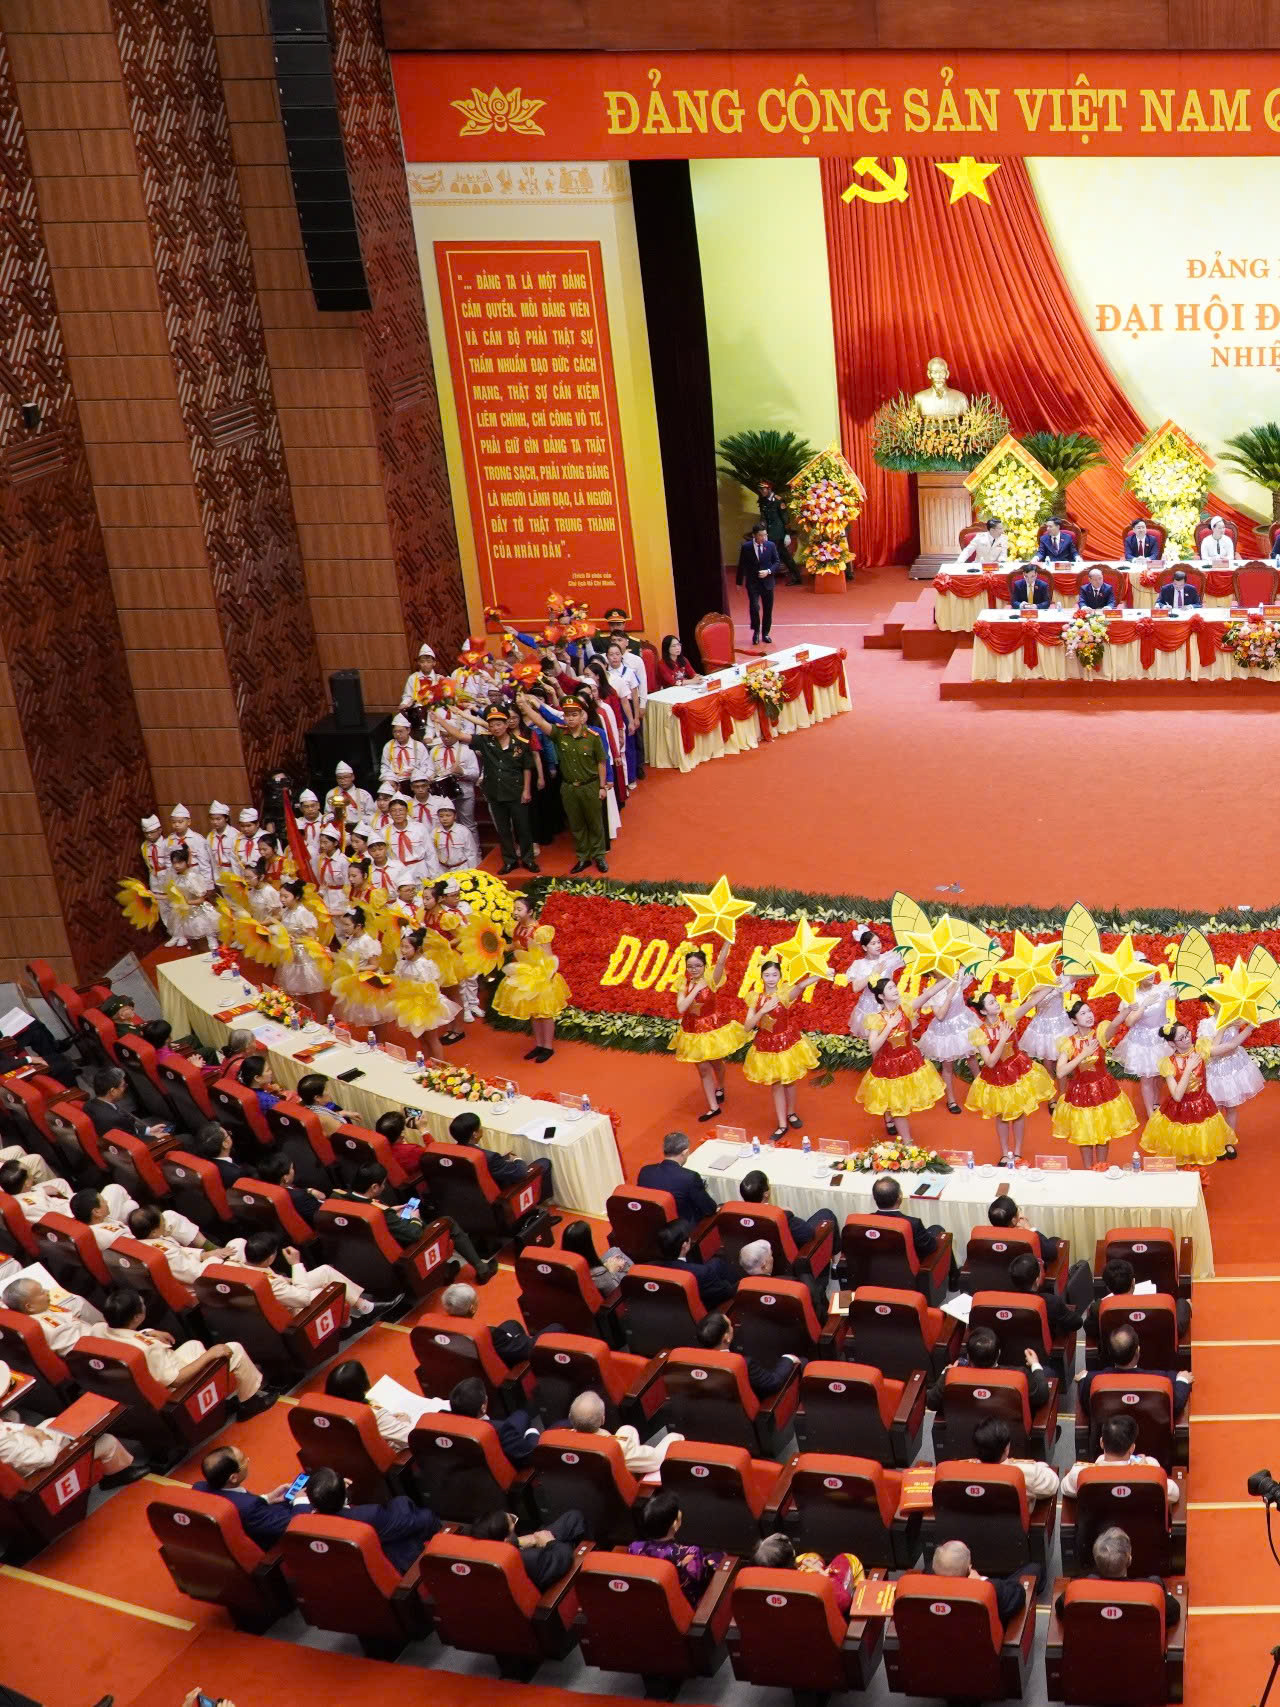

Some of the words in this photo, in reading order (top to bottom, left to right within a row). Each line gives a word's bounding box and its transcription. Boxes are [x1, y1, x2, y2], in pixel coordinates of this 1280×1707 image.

[604, 69, 745, 134] ĐẢNG
[758, 74, 891, 144] CỘNG
[904, 67, 1000, 132] SẢN
[1014, 73, 1126, 144] VIỆT
[1140, 89, 1251, 132] NAM
[1185, 251, 1269, 279] ĐẢNG
[505, 274, 517, 290] TA
[521, 271, 534, 290] LÀ
[1097, 305, 1163, 339] ĐẠI
[1174, 294, 1245, 339] HỘI
[465, 328, 478, 345] VÀ
[507, 327, 521, 348] BỘ
[570, 438, 582, 453] TA
[483, 465, 513, 480] TRONG
[487, 490, 499, 507] LÀ
[573, 488, 586, 506] LÀ
[554, 517, 583, 532] TRUNG
